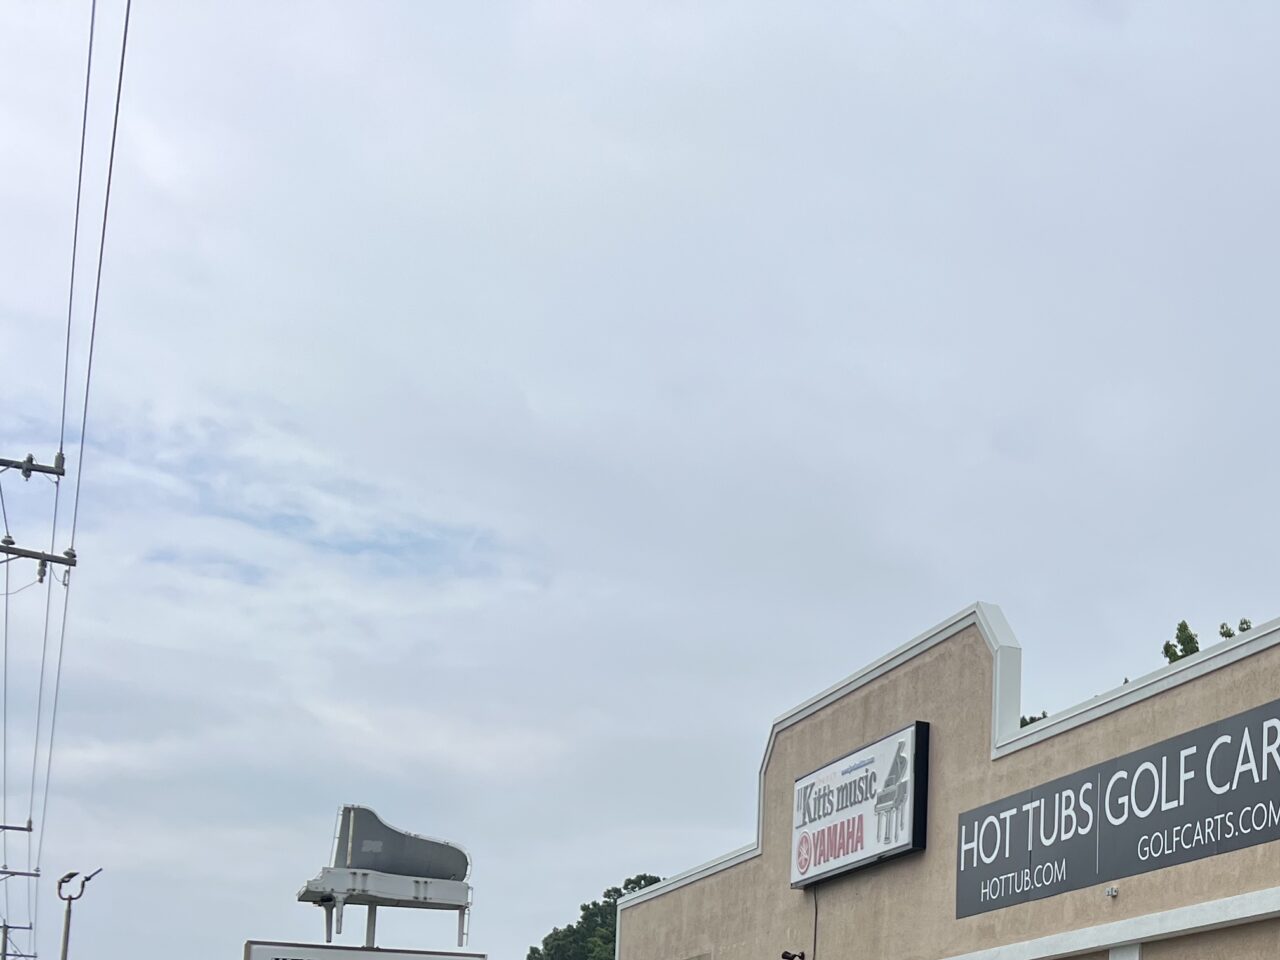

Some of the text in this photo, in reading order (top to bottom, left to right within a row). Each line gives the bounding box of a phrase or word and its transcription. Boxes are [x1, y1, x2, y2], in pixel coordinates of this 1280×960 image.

[799, 767, 877, 829] Kitt's music
[1104, 745, 1197, 826] GOLF
[811, 813, 864, 867] YAMAHA
[960, 782, 1094, 872] HOT TUBS
[980, 858, 1066, 902] HOTTUB.COM
